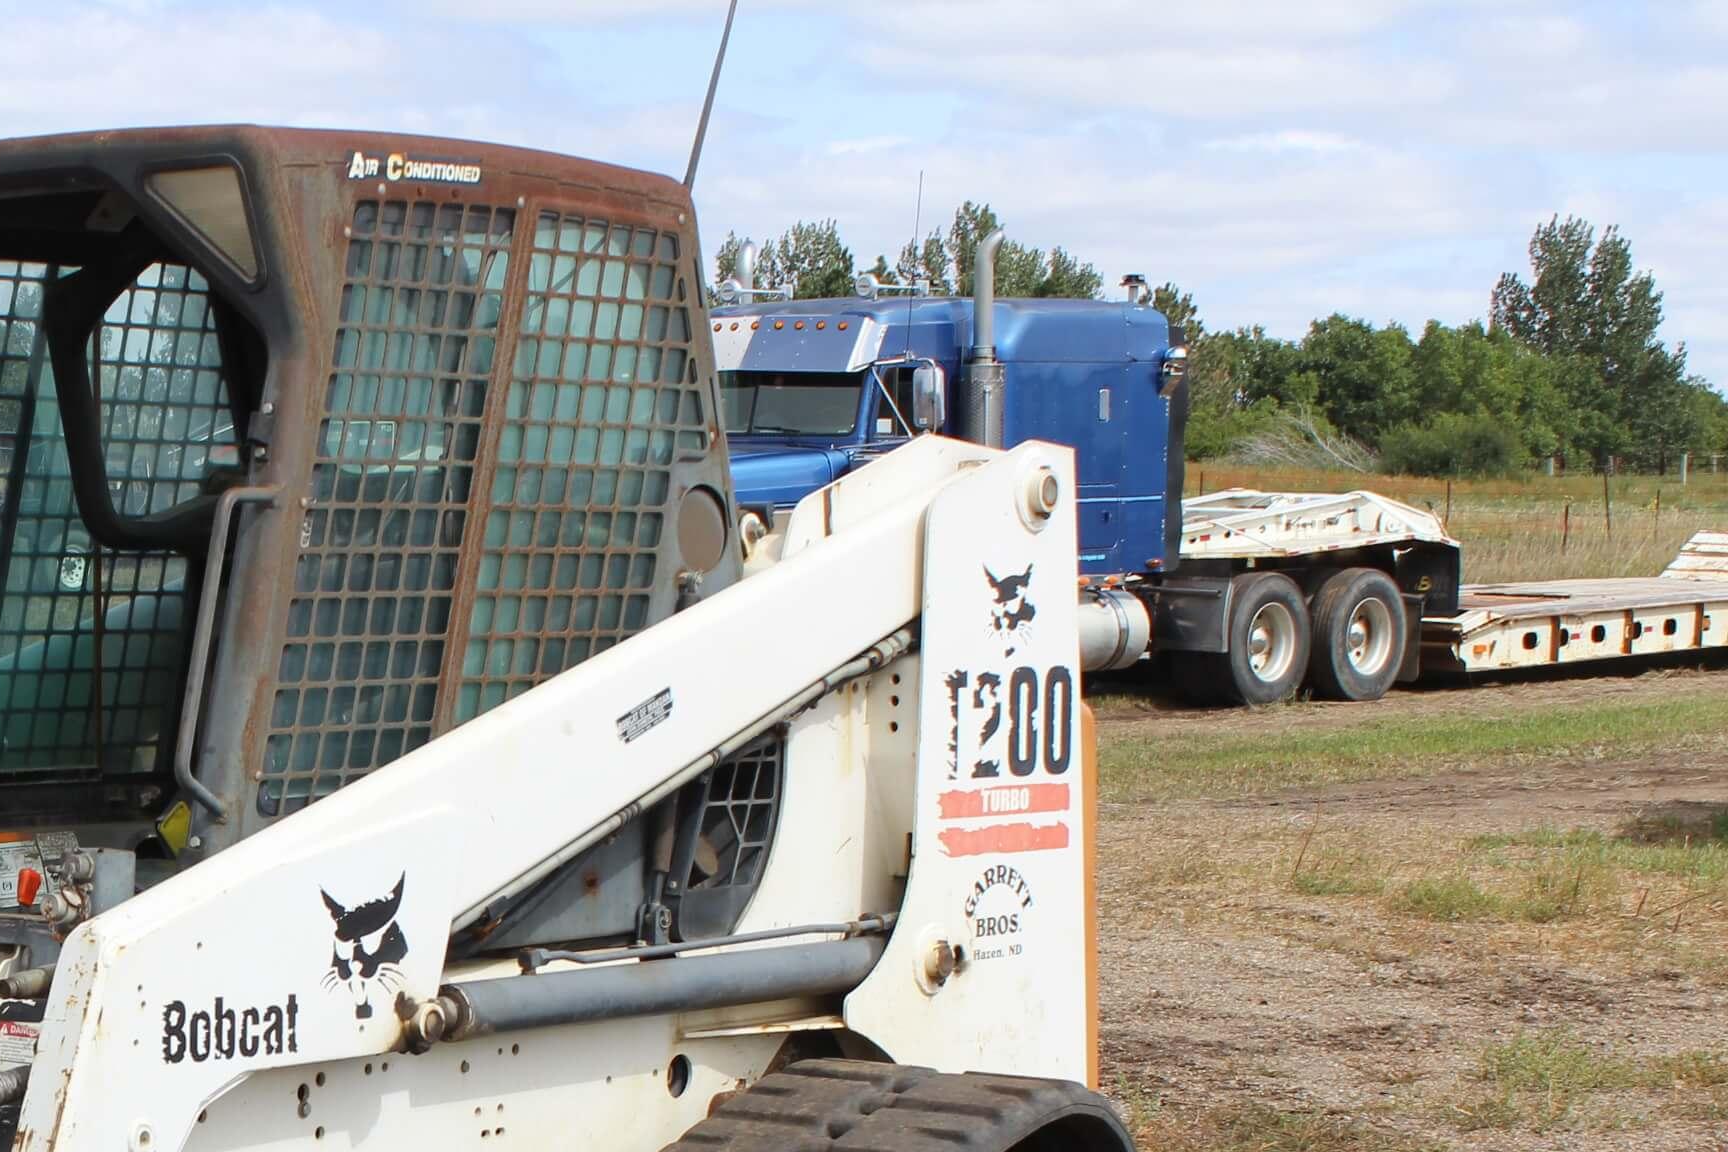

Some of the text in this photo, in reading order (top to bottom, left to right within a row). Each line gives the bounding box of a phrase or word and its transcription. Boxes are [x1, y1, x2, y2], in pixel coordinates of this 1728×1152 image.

[944, 665, 1072, 780] T200
[980, 787, 1030, 813] TURBO
[964, 864, 1034, 918] GARRETT
[975, 913, 1022, 938] BROS.
[1008, 944, 1023, 957] ND
[162, 993, 299, 1065] Bobcat
